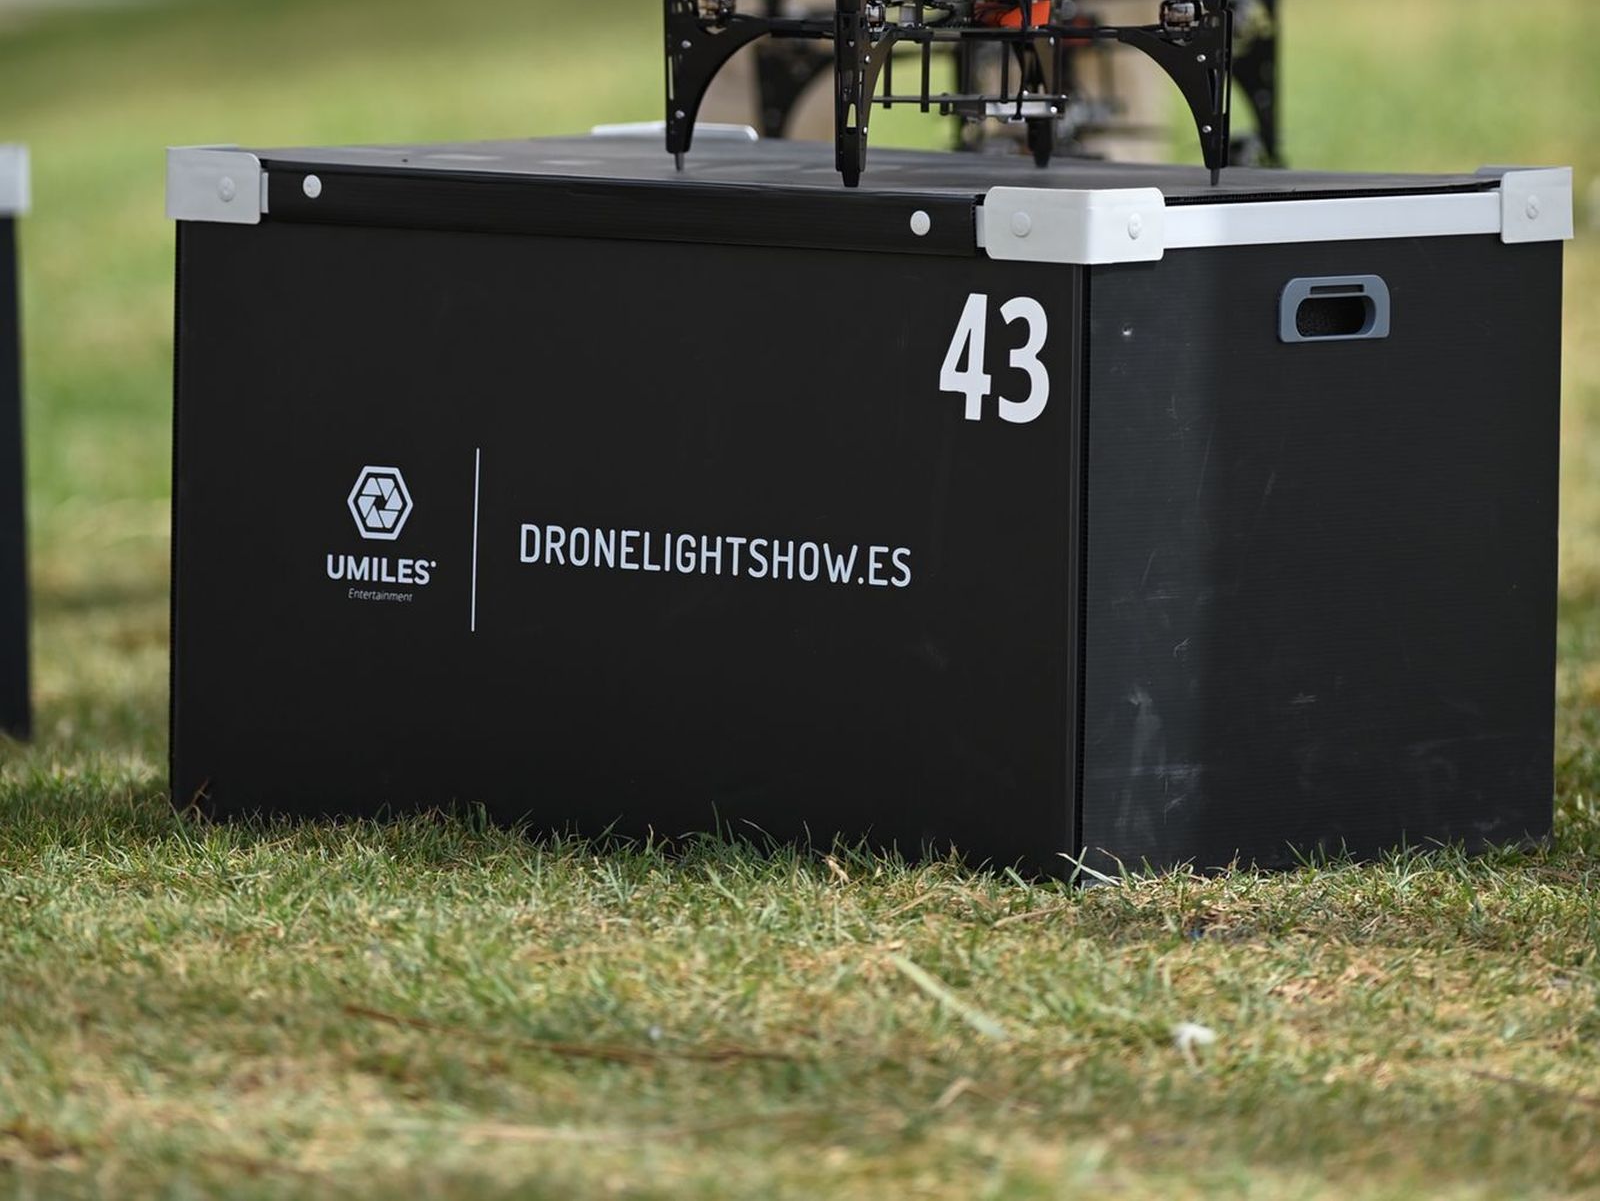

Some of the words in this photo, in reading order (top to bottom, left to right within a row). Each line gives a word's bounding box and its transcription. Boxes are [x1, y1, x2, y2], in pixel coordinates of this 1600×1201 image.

[939, 292, 1050, 424] 43
[326, 553, 431, 585] UMILES
[519, 523, 912, 588] DRONELIGHTSHOW.ES
[347, 587, 413, 602] Entertainment
